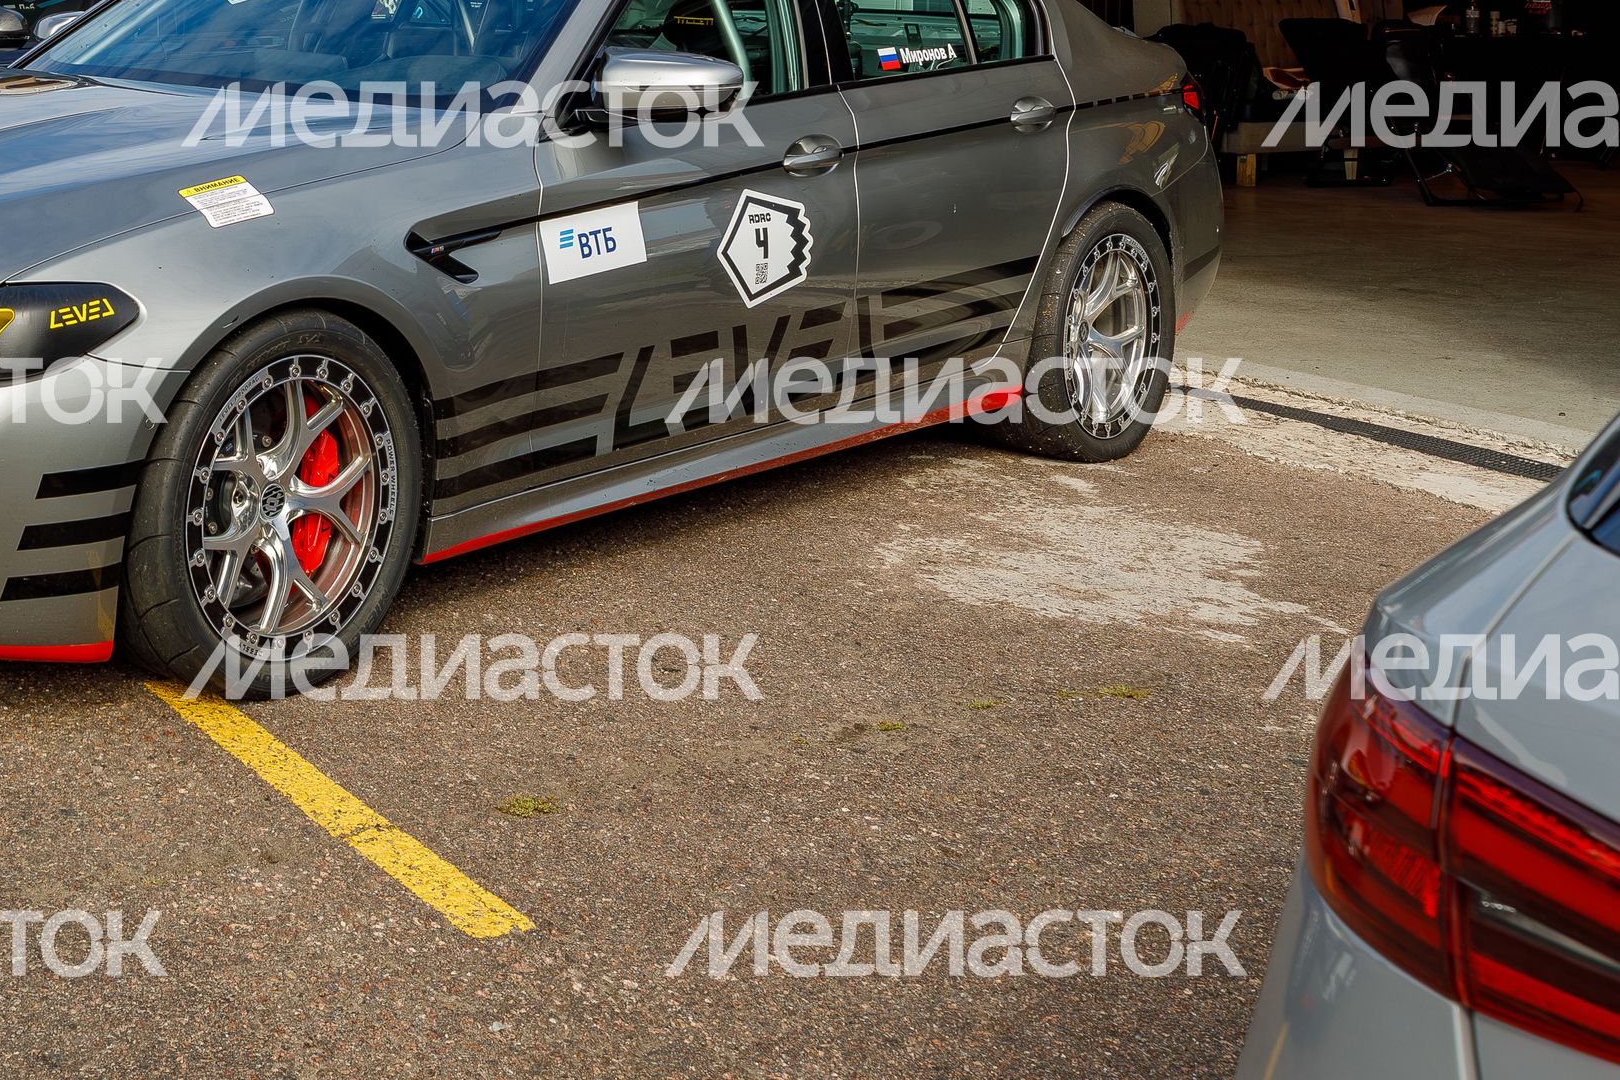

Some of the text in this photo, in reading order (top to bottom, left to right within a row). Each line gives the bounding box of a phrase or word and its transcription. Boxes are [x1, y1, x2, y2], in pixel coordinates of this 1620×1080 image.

[899, 47, 947, 66] Миронов
[194, 177, 240, 192] ВНИМАНИЕ
[579, 226, 616, 259] ВТБ
[386, 439, 395, 472] POWER
